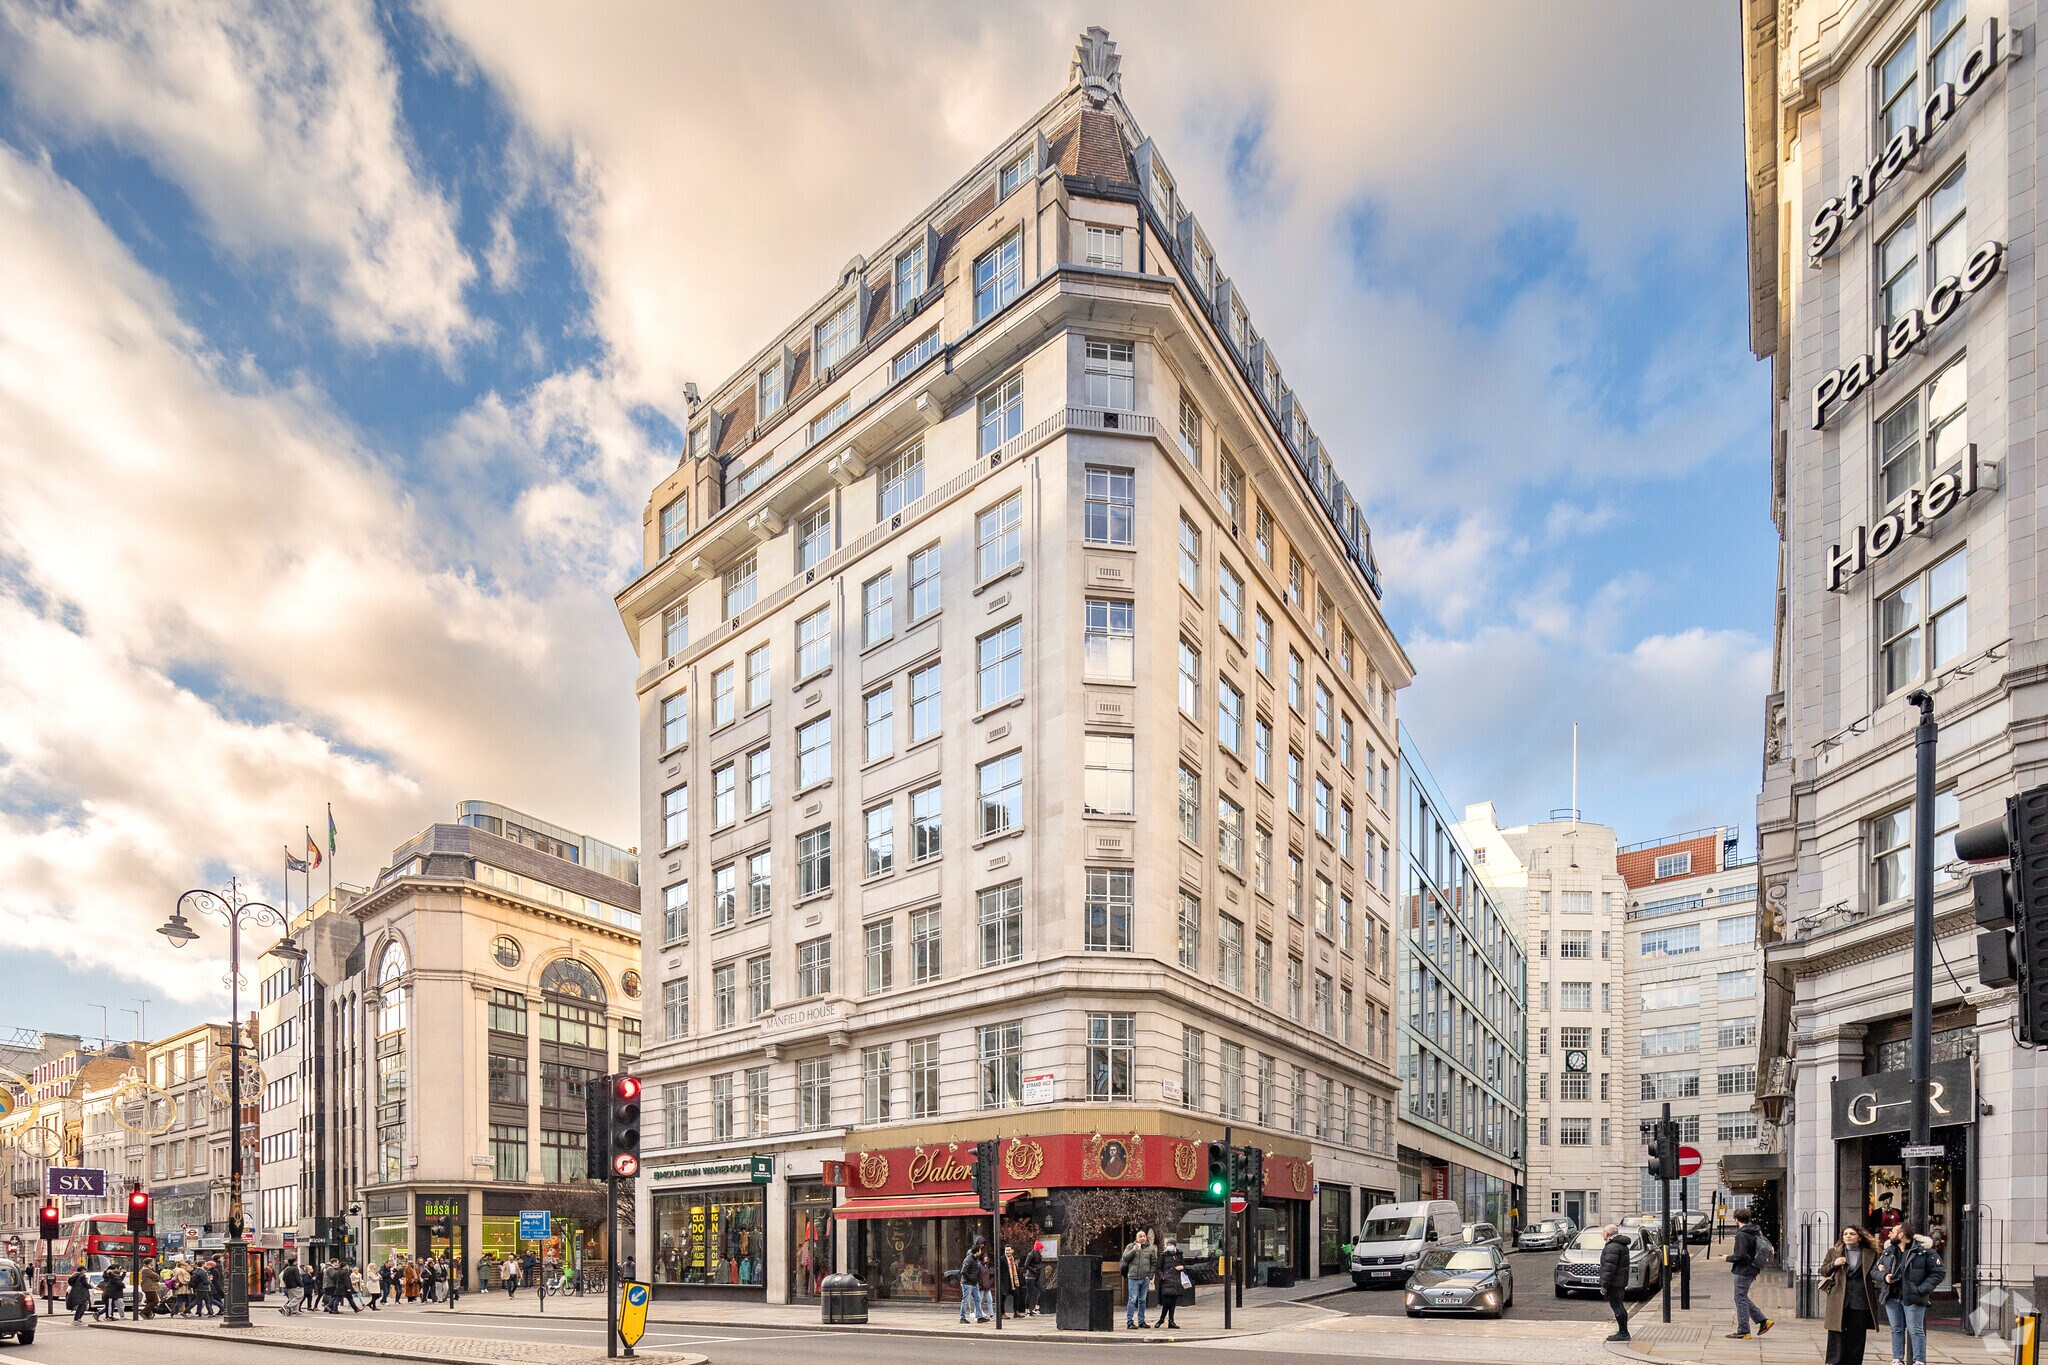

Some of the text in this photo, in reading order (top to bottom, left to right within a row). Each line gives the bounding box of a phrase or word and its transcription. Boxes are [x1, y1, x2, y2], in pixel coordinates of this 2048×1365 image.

[1807, 16, 1999, 258] Strand
[1811, 240, 2003, 431] Palace
[1826, 443, 1978, 592] Hotel
[766, 1004, 836, 1029] MANFIELD HOUSE
[659, 1163, 751, 1180] MOUNTAIN WAREHOUS
[908, 1149, 977, 1190] Salier
